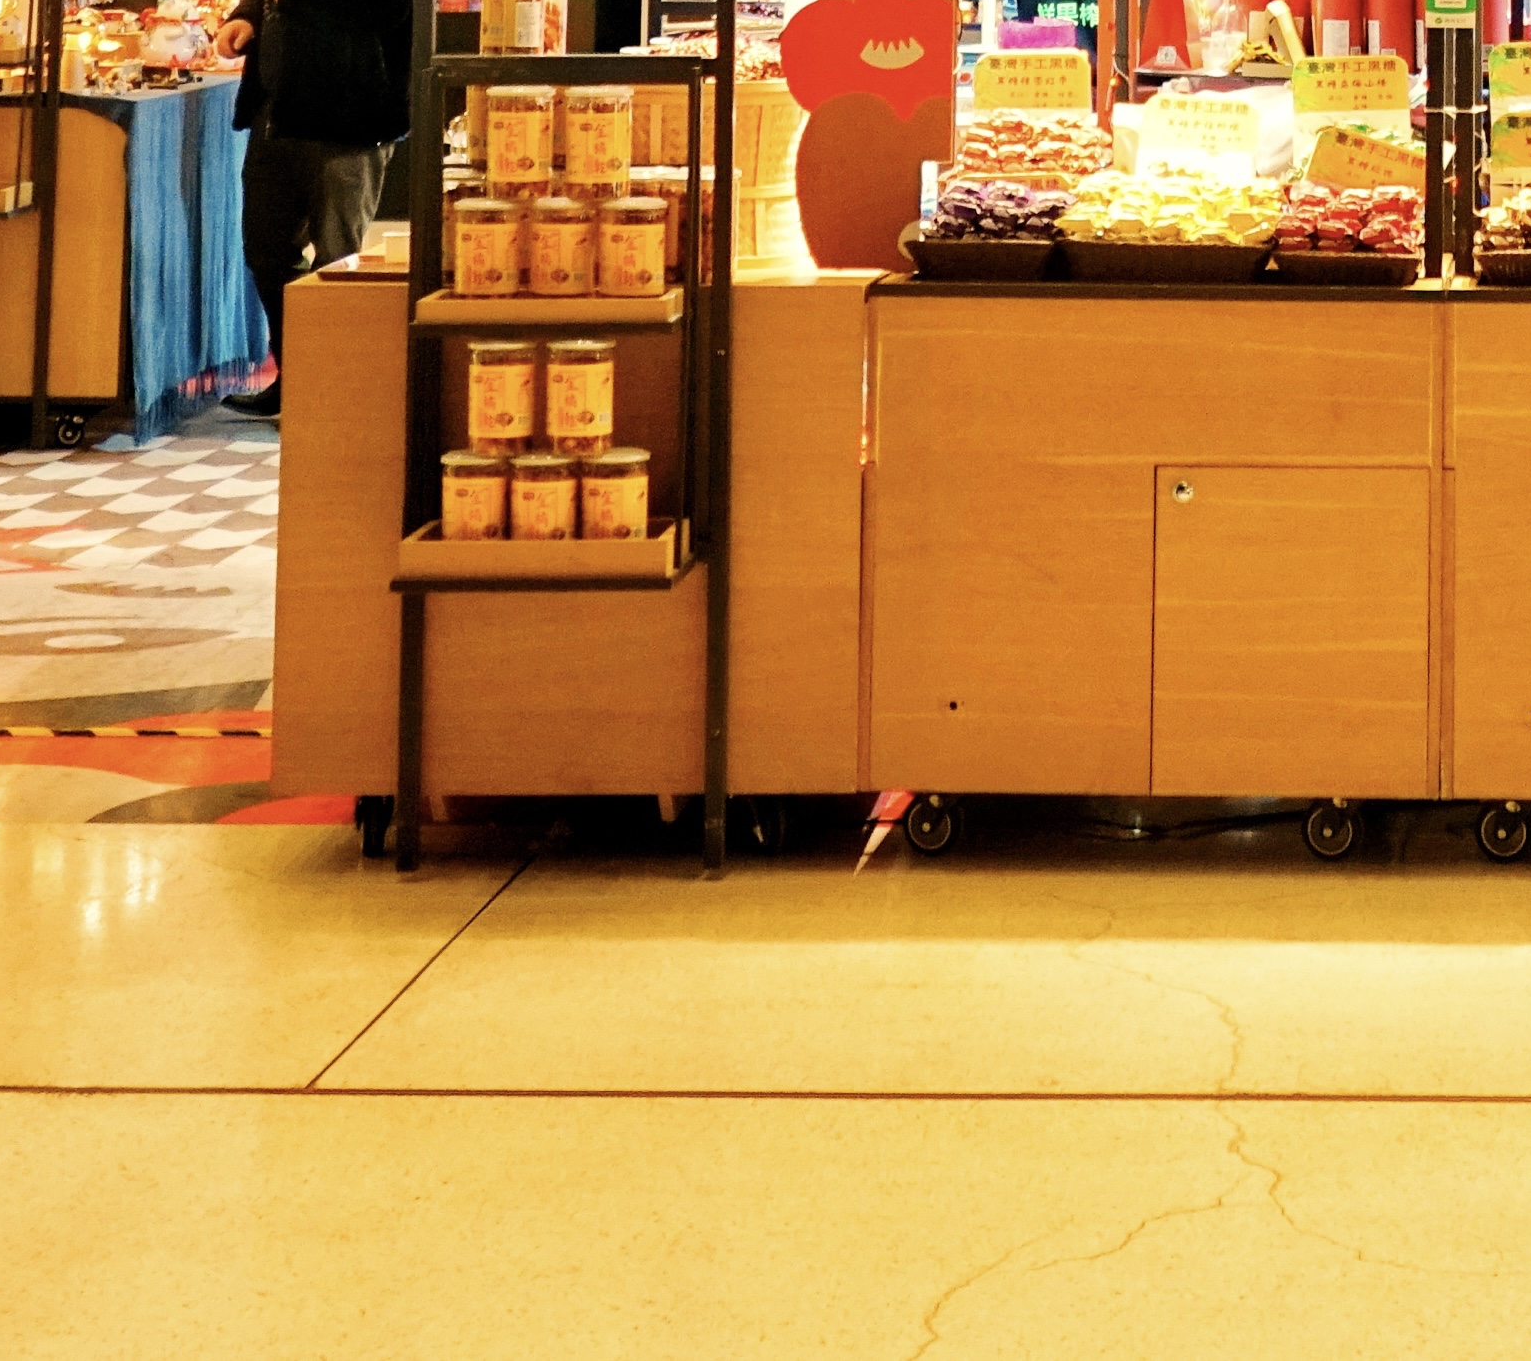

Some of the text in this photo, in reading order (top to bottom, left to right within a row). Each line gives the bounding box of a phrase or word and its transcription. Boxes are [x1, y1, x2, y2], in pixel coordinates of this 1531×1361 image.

[989, 57, 1079, 71] 臺灣手工黑糖
[1307, 59, 1397, 76] 臺灣手工黑糖
